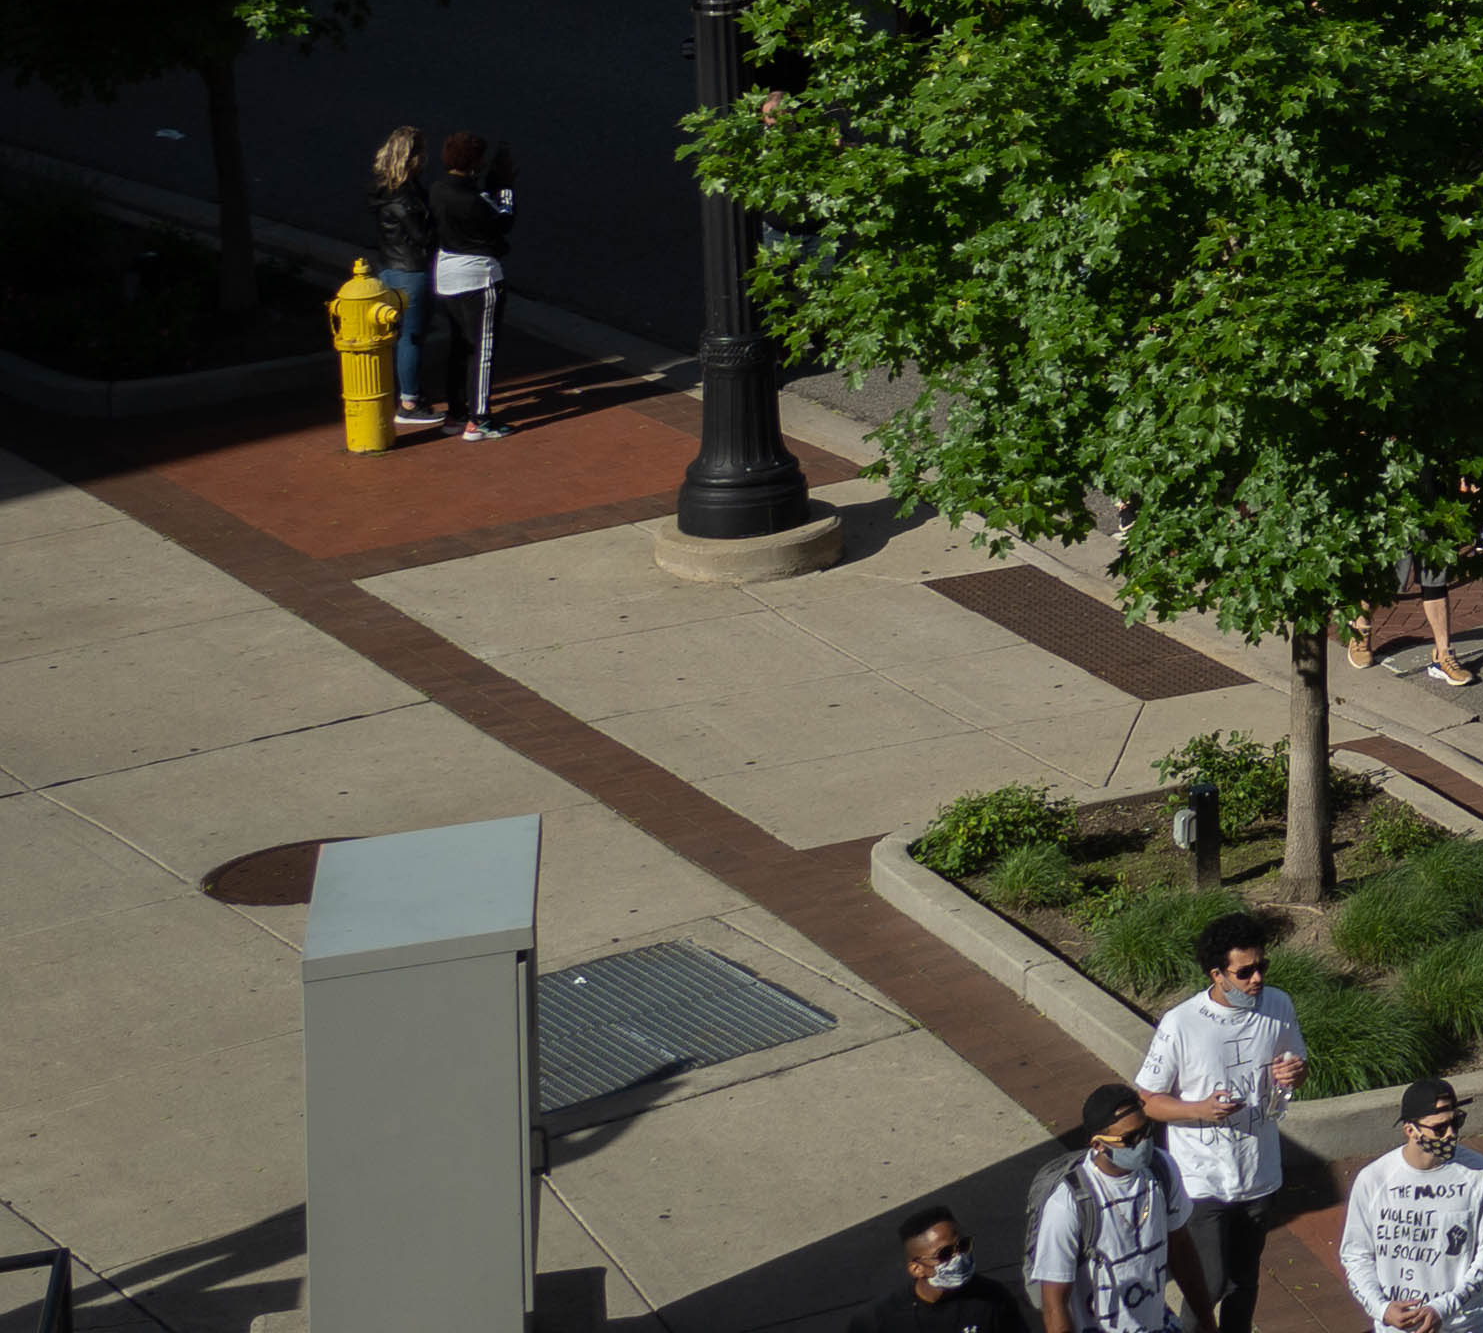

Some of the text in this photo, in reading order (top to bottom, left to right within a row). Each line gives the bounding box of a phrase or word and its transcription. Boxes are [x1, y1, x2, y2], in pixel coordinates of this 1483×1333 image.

[1390, 1182, 1468, 1199] THE MOST
[1381, 1208, 1437, 1227] VIOLENT
[1376, 1225, 1438, 1241] ELEMENT
[1390, 1242, 1442, 1267] SOCIETY
[1400, 1267, 1414, 1282] IS
